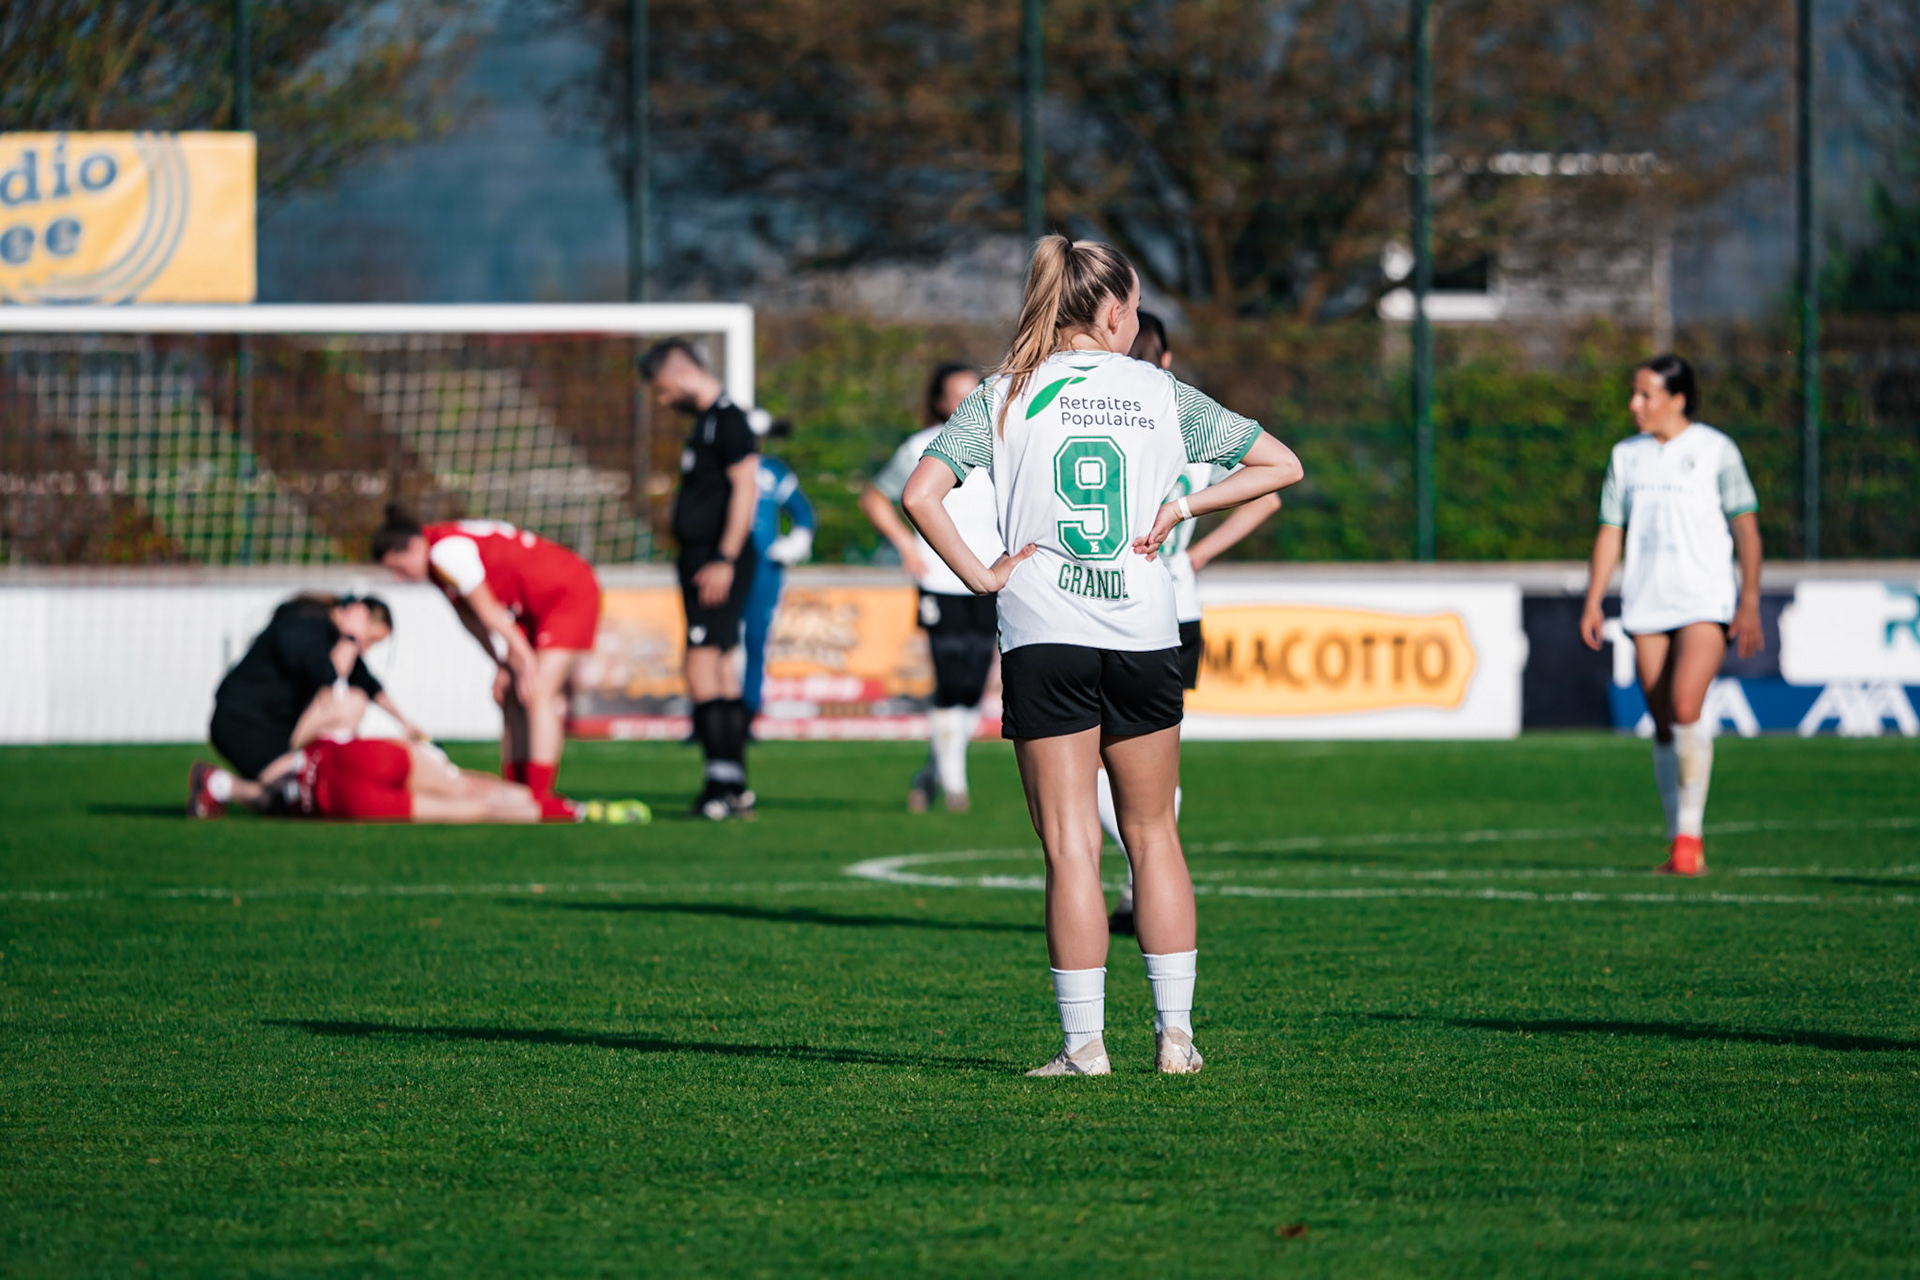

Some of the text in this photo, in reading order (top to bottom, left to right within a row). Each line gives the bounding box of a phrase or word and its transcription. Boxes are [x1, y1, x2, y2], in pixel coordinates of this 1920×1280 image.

[1060, 396, 1142, 412] Retraites
[1061, 411, 1155, 430] Populaires
[1054, 436, 1128, 560] 9
